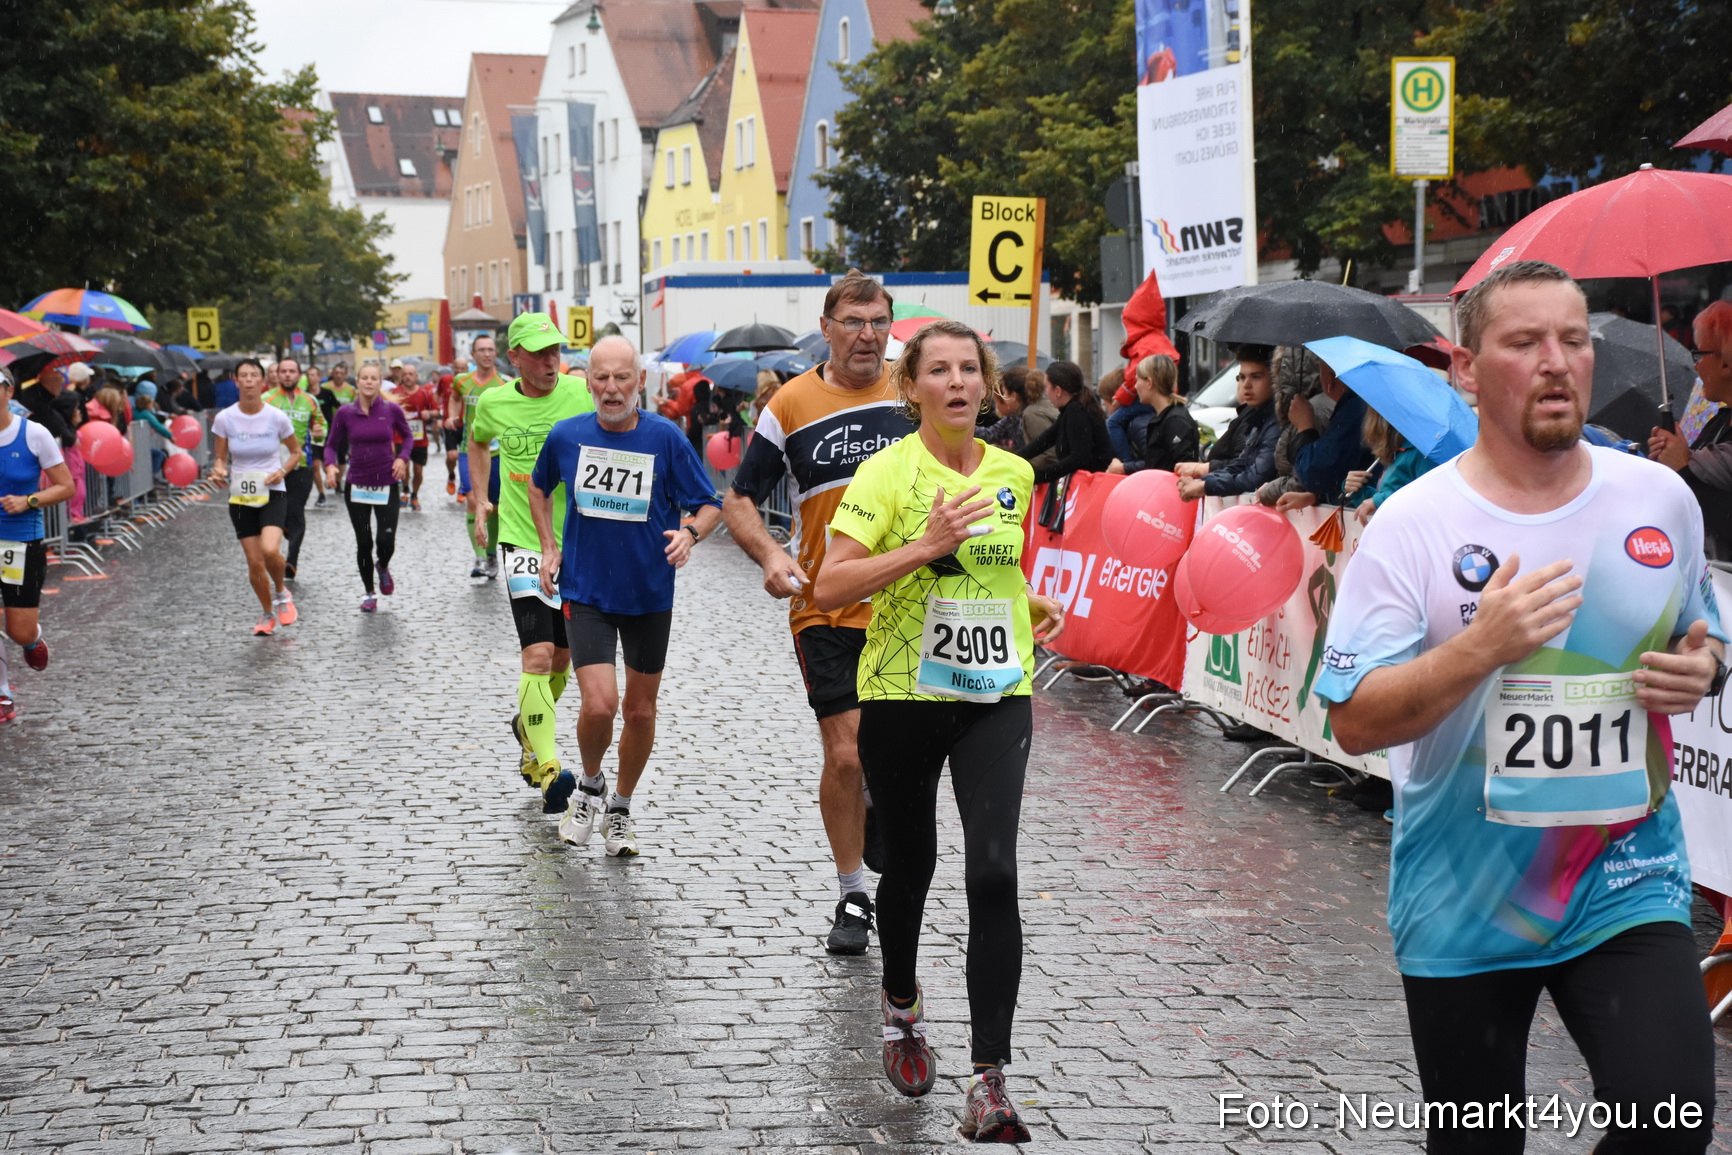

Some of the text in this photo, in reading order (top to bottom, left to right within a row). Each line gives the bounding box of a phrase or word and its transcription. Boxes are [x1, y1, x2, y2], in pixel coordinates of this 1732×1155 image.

[1413, 78, 1433, 102] H
[981, 202, 1037, 222] Block
[988, 230, 1024, 283] C
[197, 321, 211, 341] D
[574, 319, 586, 339] D
[241, 481, 256, 494] 96
[583, 464, 643, 495] 2471
[593, 497, 629, 512] Norbert
[851, 504, 876, 522] Partl
[969, 545, 1014, 555] THE NEXT
[1212, 523, 1262, 569] RÖDL
[1632, 538, 1671, 556] Hervis
[976, 556, 992, 565] 100
[1232, 548, 1257, 573] energie
[962, 604, 1007, 616] BOCK
[933, 623, 1008, 665] 2909
[952, 672, 996, 690] Nicola
[1564, 679, 1634, 700] BOCK
[1500, 692, 1554, 702] NeuerMarkt
[1505, 709, 1631, 769] 2011
[1493, 765, 1501, 775] A
